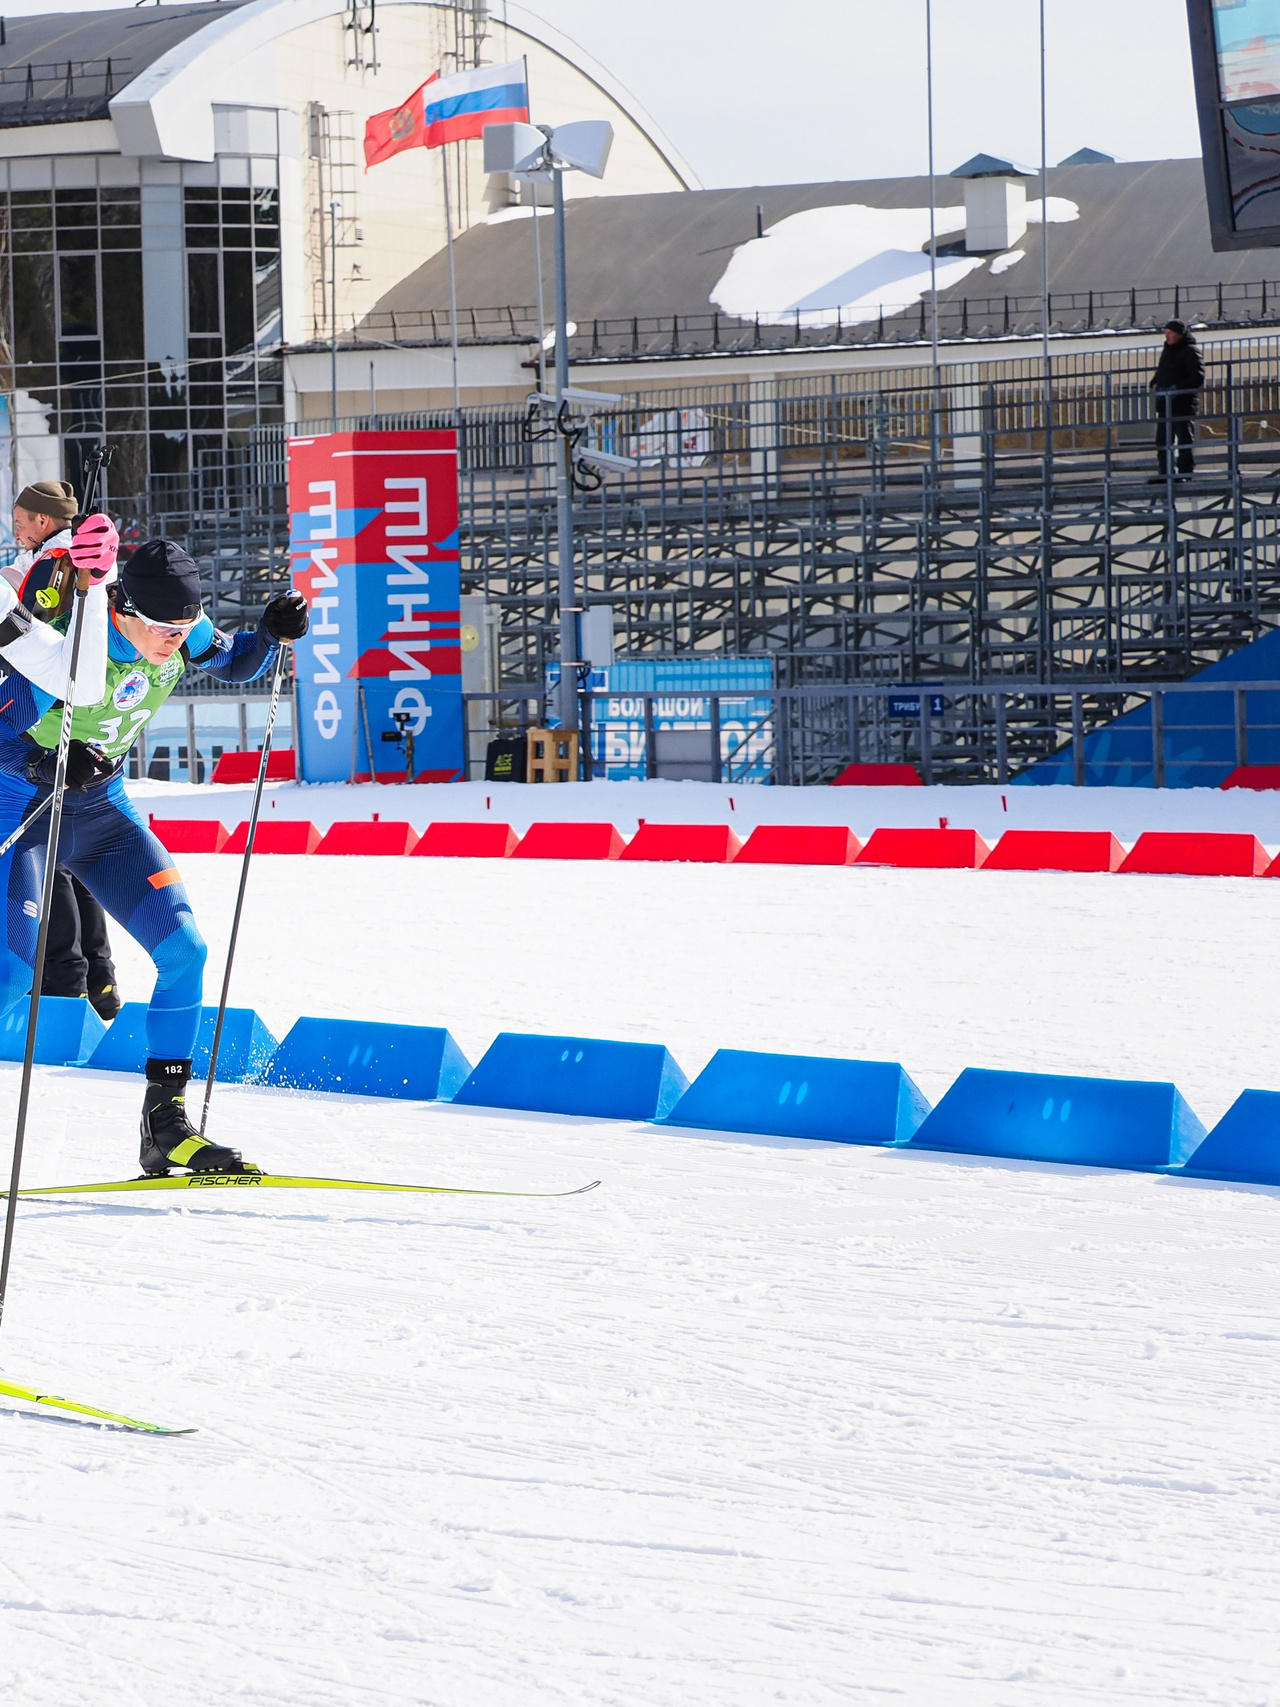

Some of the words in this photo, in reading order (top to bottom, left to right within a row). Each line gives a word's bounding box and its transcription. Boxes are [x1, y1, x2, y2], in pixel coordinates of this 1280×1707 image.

[307, 479, 343, 741] ФИНИШ
[383, 476, 433, 738] ФИНИШ
[933, 697, 942, 711] 1
[86, 708, 152, 745] 32
[164, 1065, 183, 1075] 182
[187, 1175, 262, 1187] FISCHER
